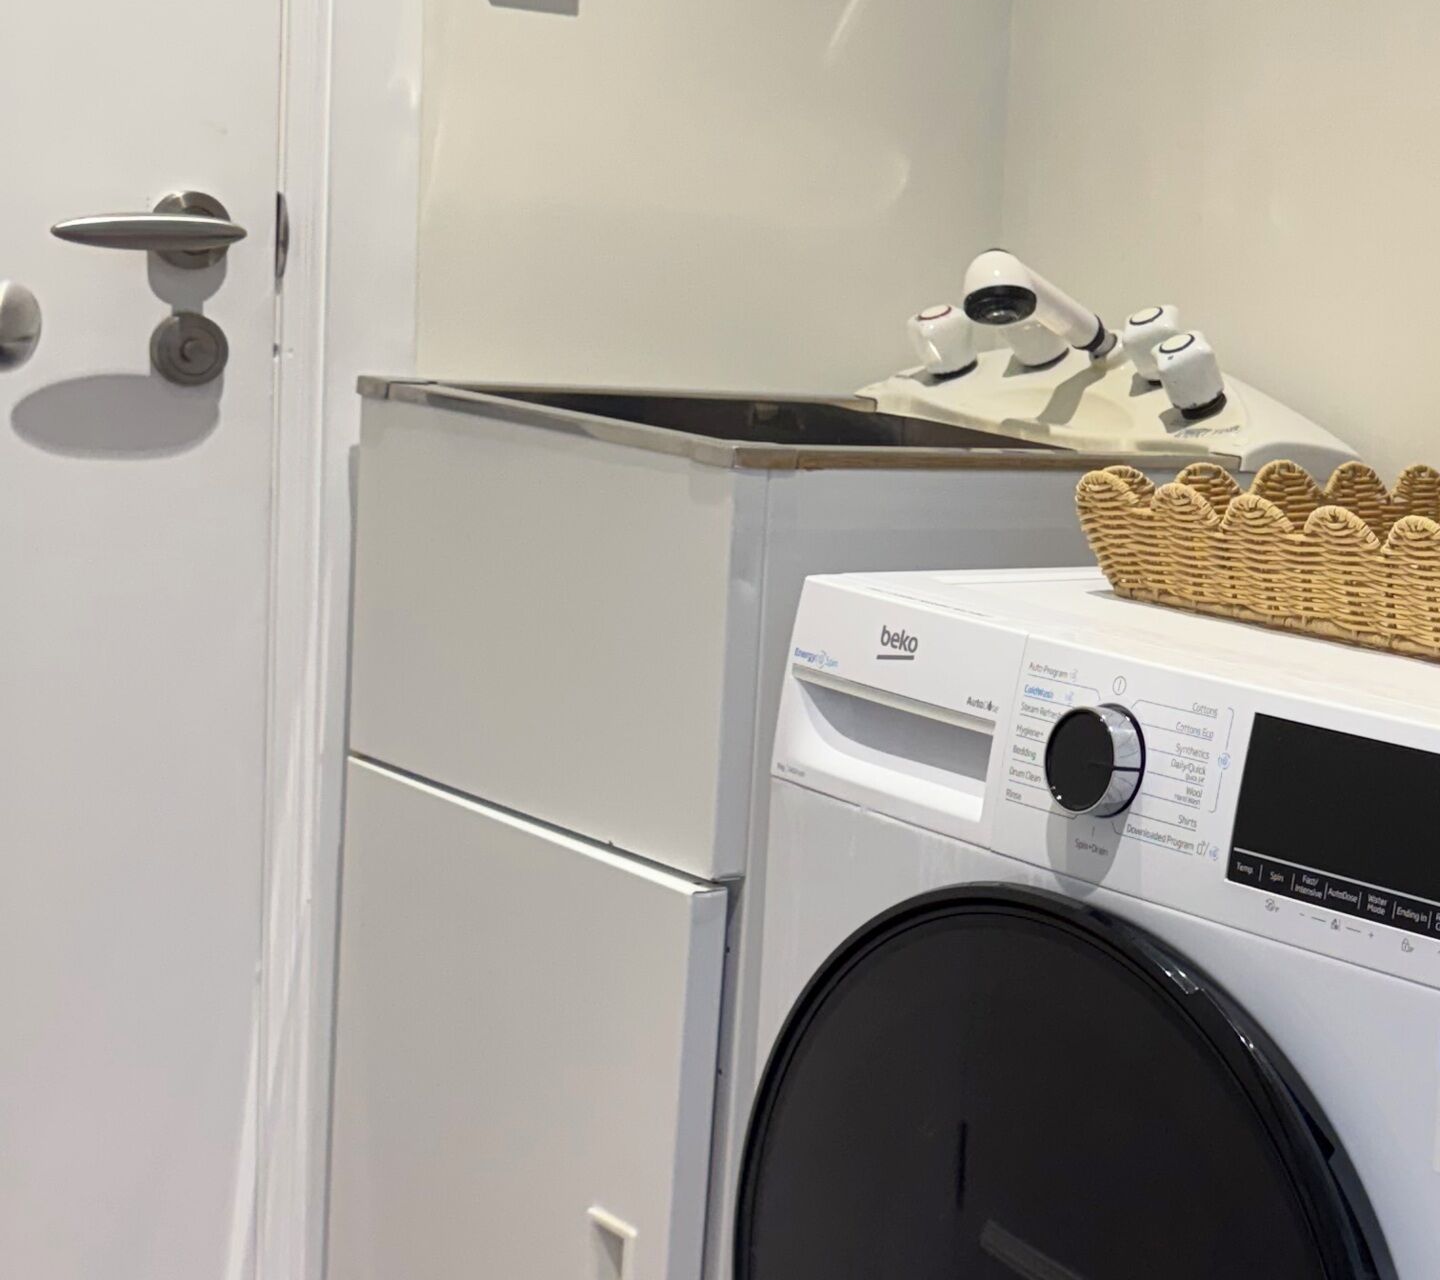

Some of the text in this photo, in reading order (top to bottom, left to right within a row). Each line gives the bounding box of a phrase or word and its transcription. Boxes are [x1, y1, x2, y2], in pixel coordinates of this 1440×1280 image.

[880, 624, 919, 653] beko
[1192, 702, 1218, 716] Cottons
[1176, 721, 1214, 739] Cottons Eco
[1013, 745, 1037, 761] Bedding
[1176, 743, 1210, 760] Synthetics
[1025, 770, 1042, 784] Clean
[1006, 788, 1022, 800] Rinse
[1186, 786, 1203, 797] Wool
[1178, 814, 1198, 828] Shirts
[1126, 823, 1194, 851] Downloaded Program
[1270, 871, 1284, 882] Spin
[1294, 884, 1323, 899] Intensive
[1366, 904, 1386, 916] Mode
[1396, 906, 1420, 923] Ending
